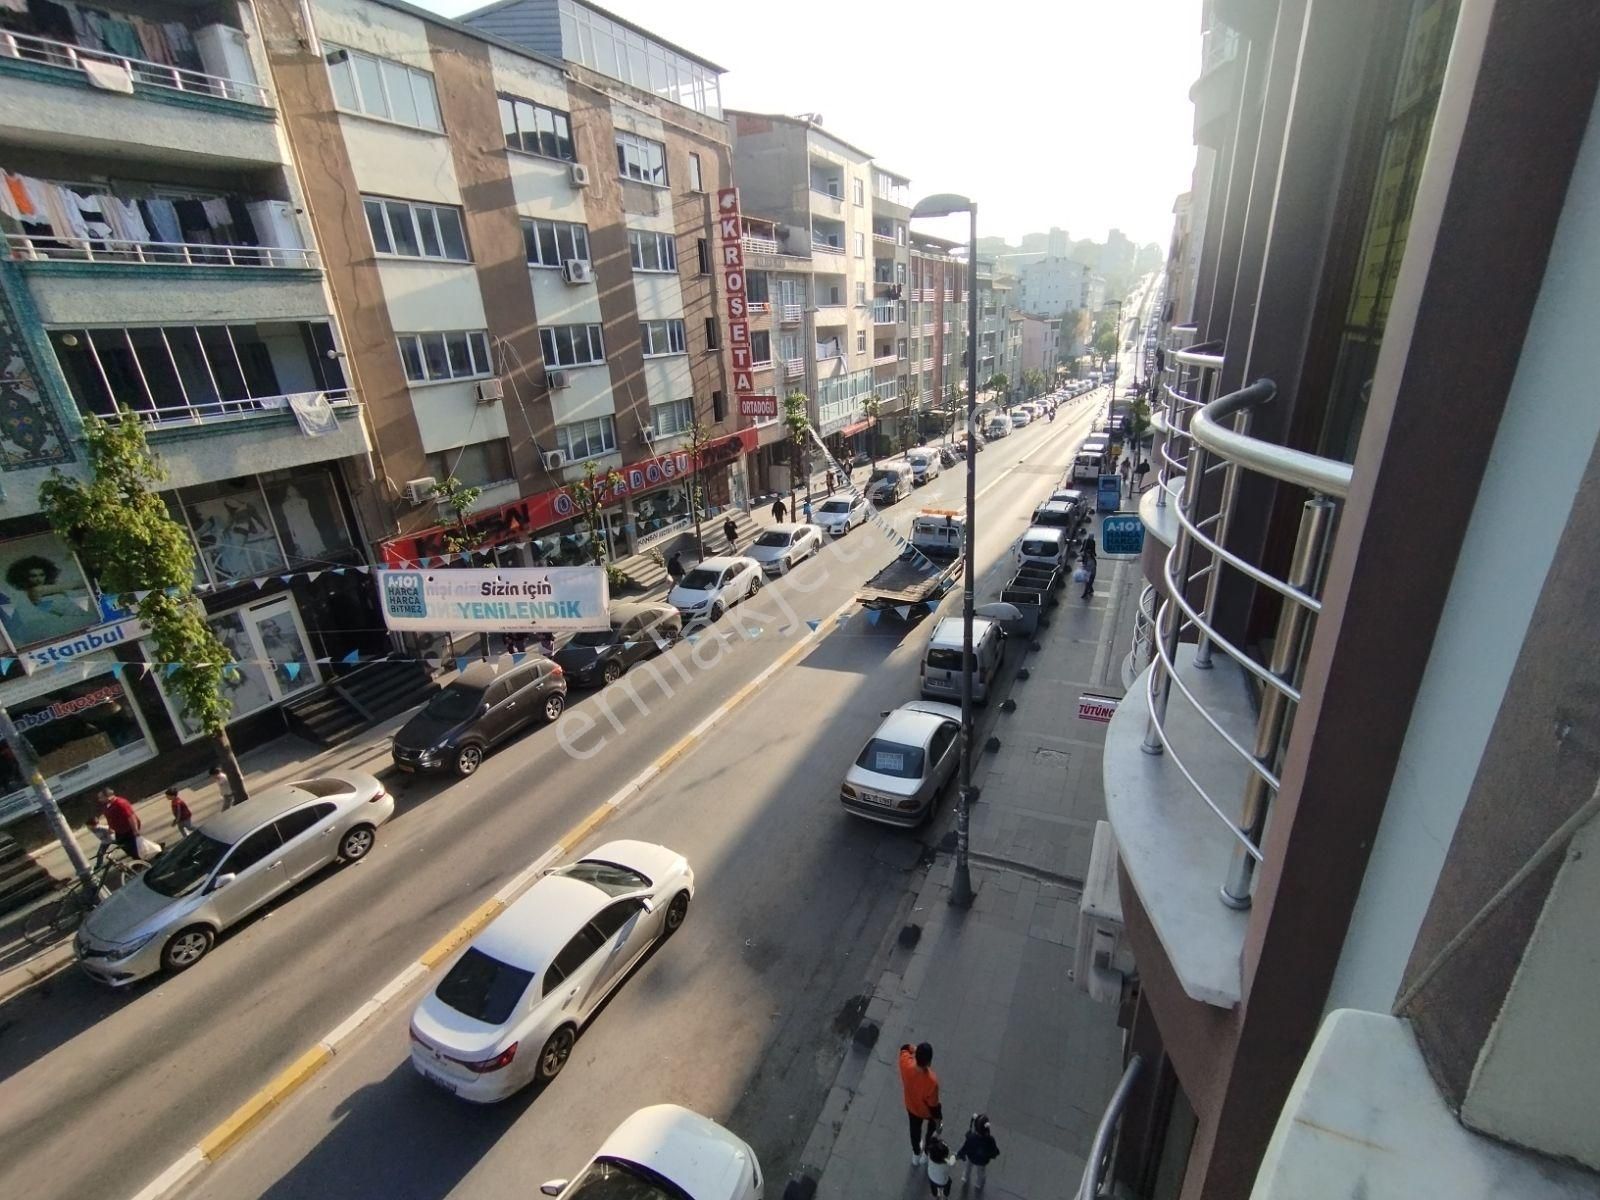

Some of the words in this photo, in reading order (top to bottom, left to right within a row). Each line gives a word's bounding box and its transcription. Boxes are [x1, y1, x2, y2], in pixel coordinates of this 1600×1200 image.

[721, 219, 752, 390] KROŞETA
[741, 398, 775, 414] ORTADOĞU
[554, 453, 689, 515] OTADOĞU
[388, 588, 419, 596] HARCA
[480, 581, 520, 596] Sizin
[522, 581, 552, 600] için
[389, 596, 421, 605] HARCA
[28, 626, 125, 665] istanbul
